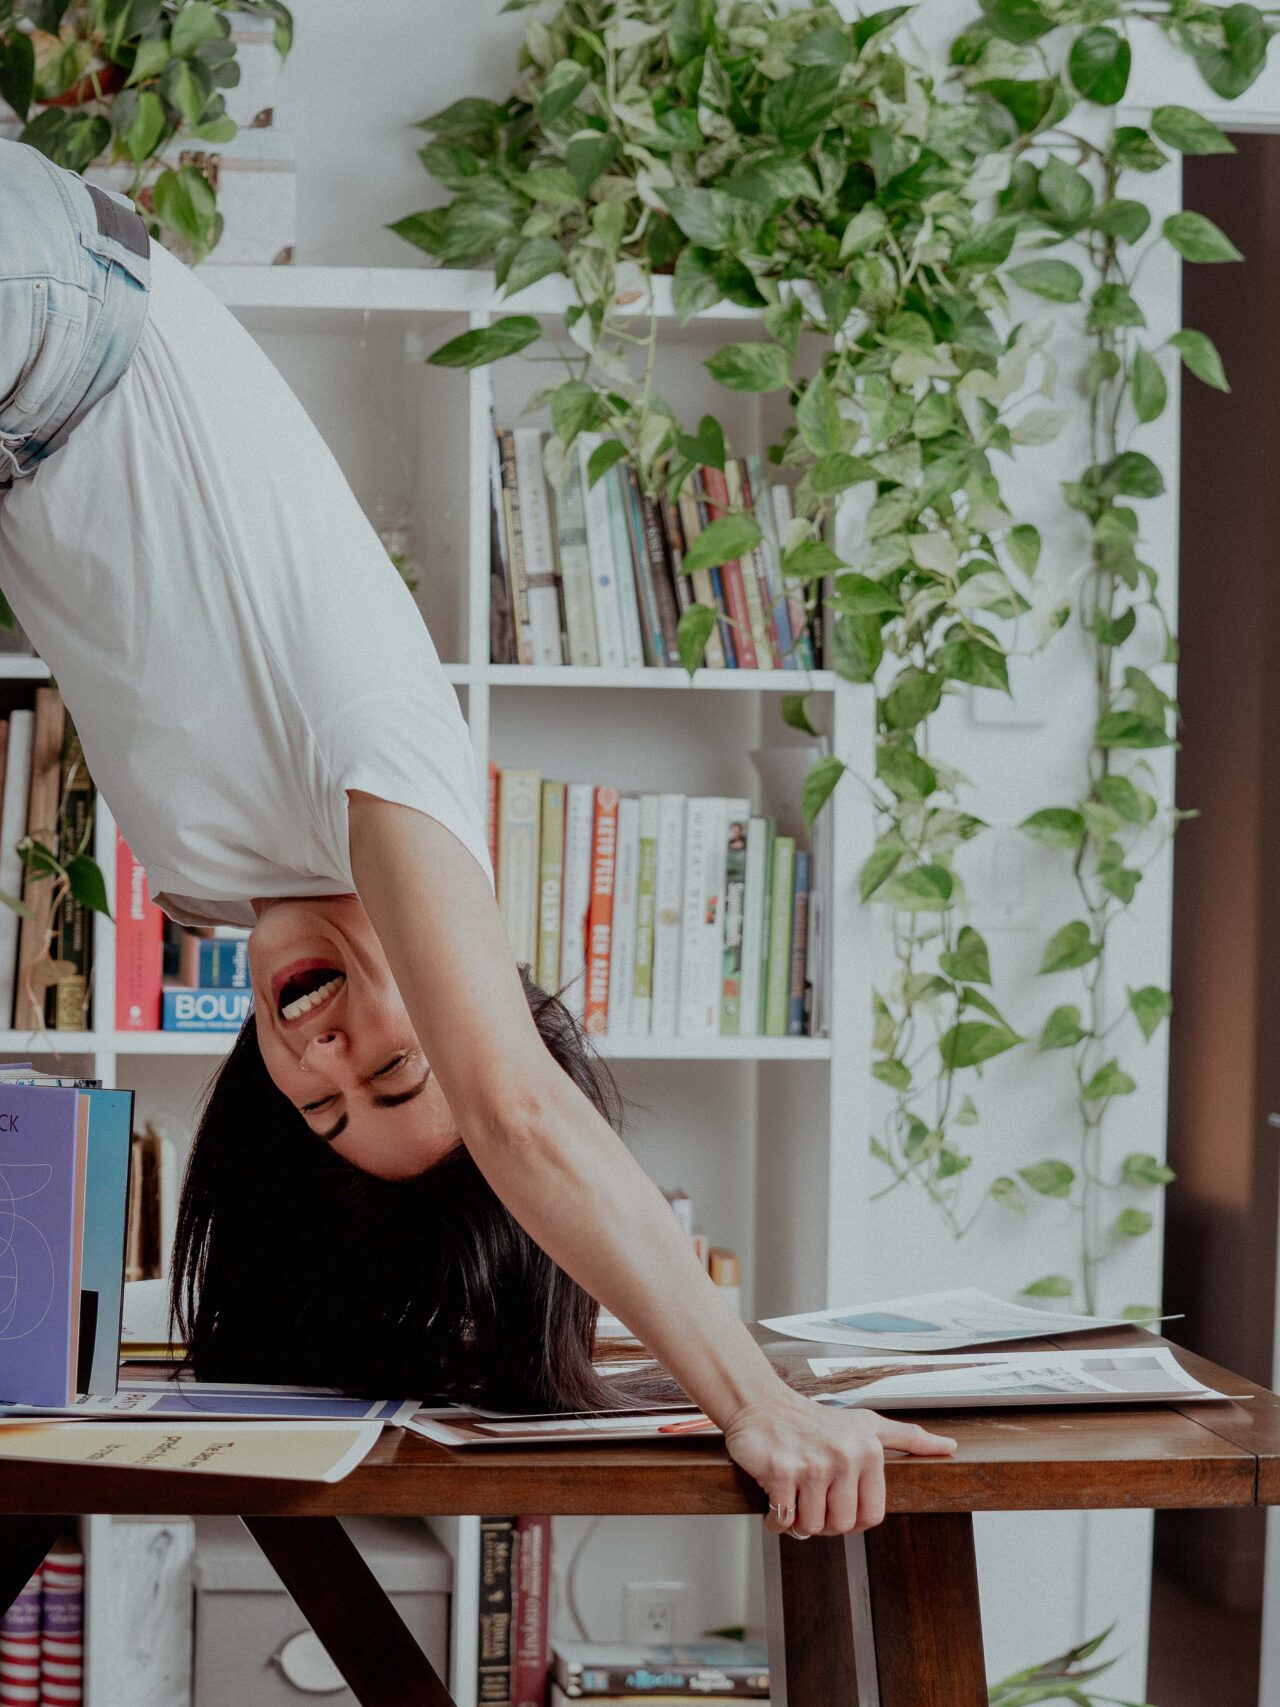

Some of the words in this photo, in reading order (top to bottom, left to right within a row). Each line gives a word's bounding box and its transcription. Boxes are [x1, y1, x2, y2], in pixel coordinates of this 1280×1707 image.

[597, 814, 616, 857] KETO
[595, 859, 615, 896] FLEX
[592, 924, 611, 956] BEN
